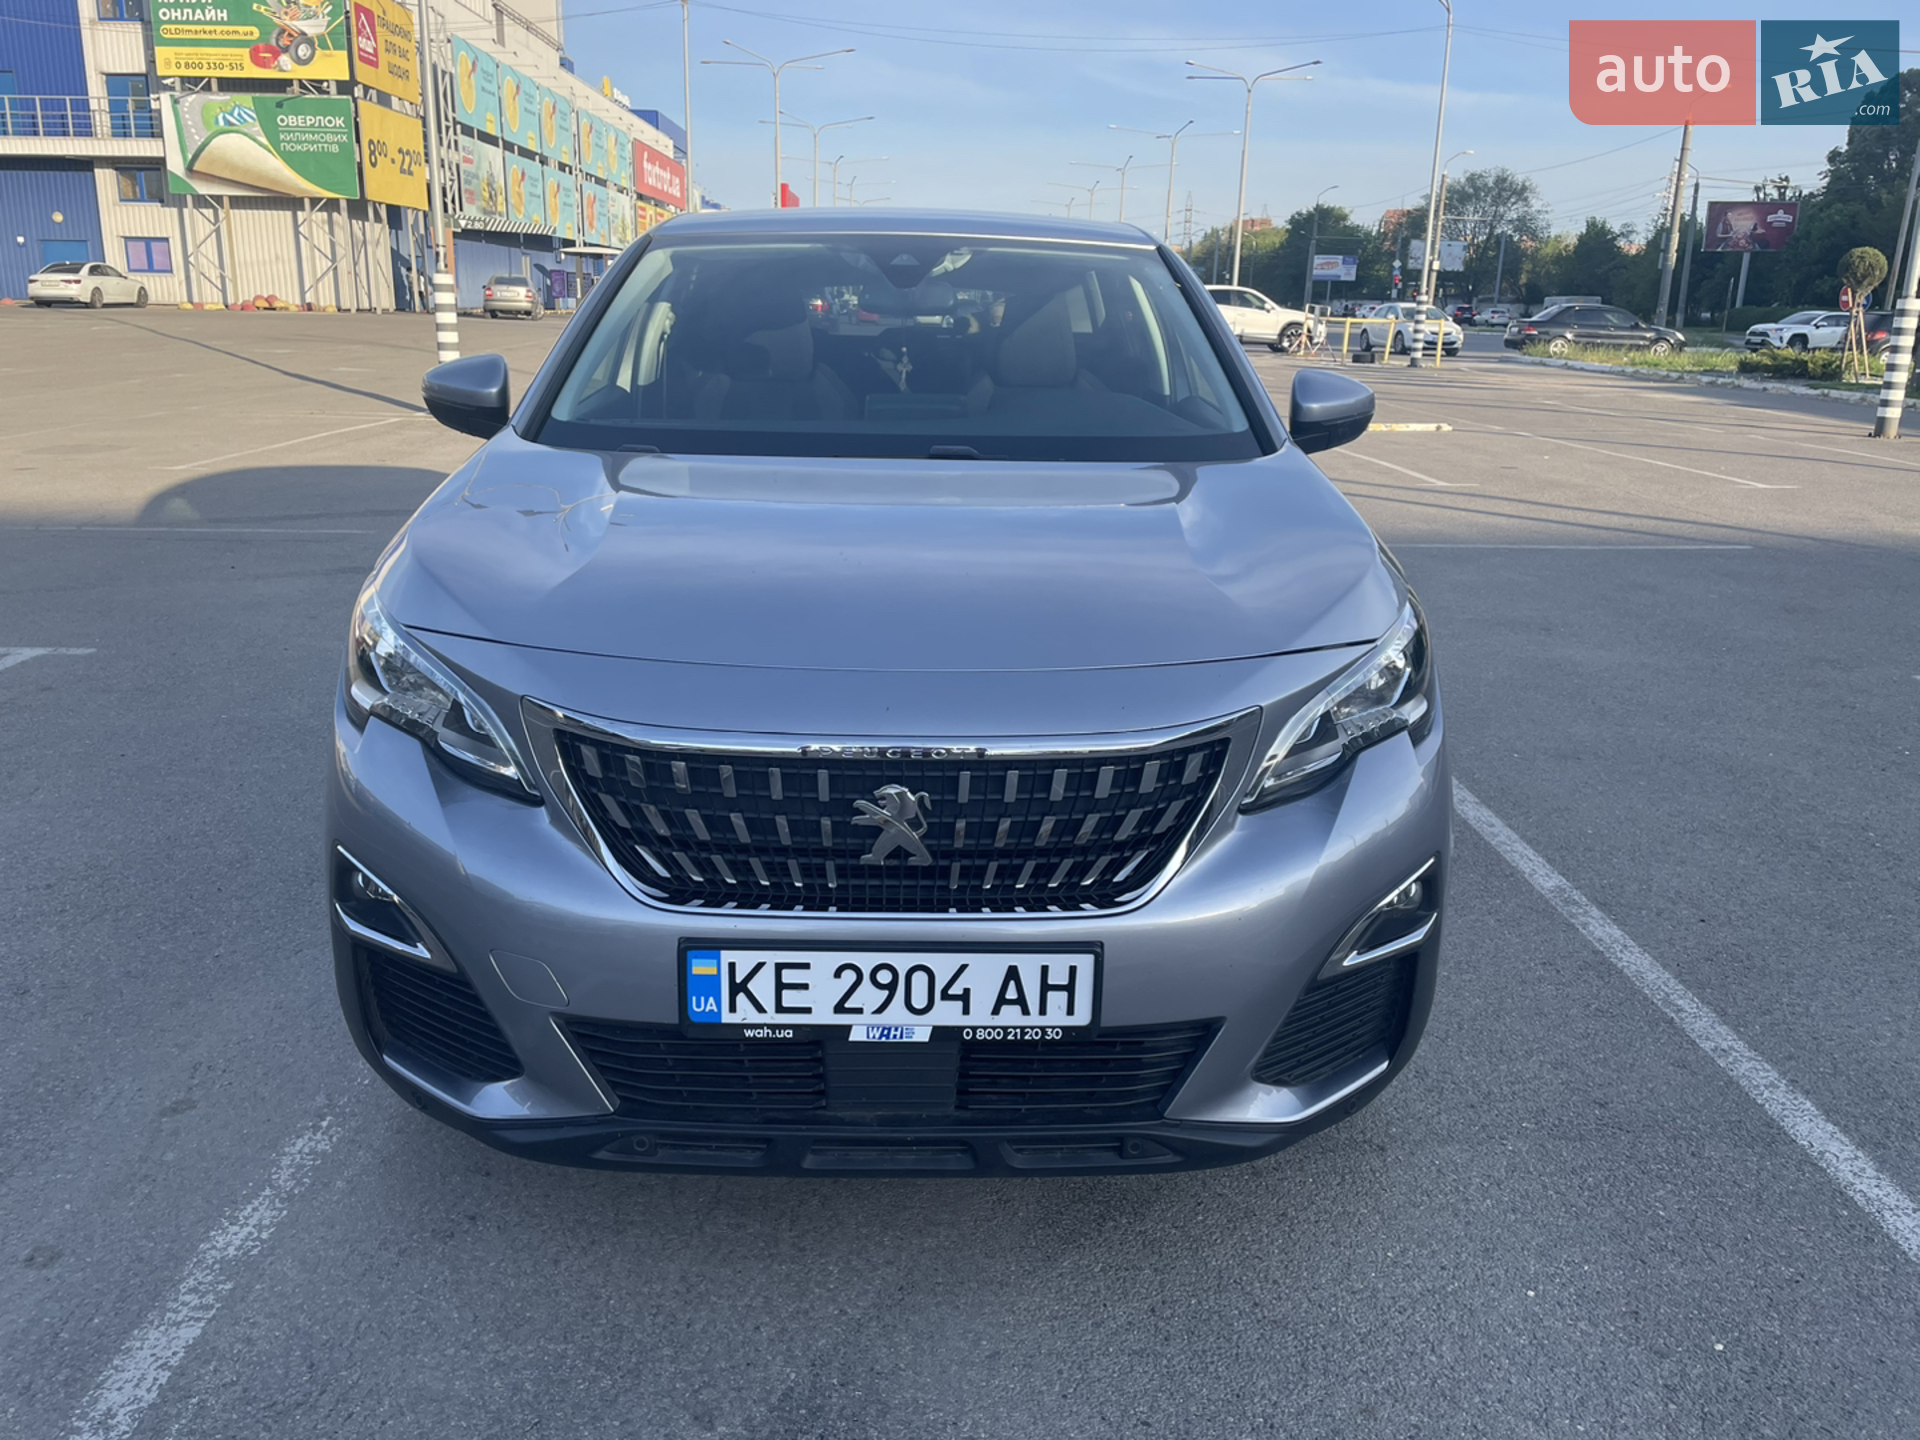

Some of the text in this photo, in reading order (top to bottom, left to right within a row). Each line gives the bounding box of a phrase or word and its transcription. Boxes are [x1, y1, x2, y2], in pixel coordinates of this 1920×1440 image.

[158, 6, 228, 21] ОНЛАЙН
[175, 61, 182, 70] 0
[184, 61, 204, 70] 800
[276, 115, 346, 128] ОВЕРЛОК
[279, 132, 349, 143] КИЛИМОВИХ
[280, 143, 340, 153] ПОКРИТТІВ
[467, 220, 485, 230] 2.80
[818, 745, 977, 759] PEUGEOT
[692, 961, 1078, 1017] UA KE 2904 AH
[744, 1026, 793, 1039] wah.ua
[866, 1026, 903, 1040] WAH
[962, 1028, 973, 1040] 0
[976, 1028, 1003, 1040] 800
[1006, 1028, 1021, 1040] 21
[1024, 1028, 1042, 1040] 20
[1044, 1028, 1062, 1040] 30
